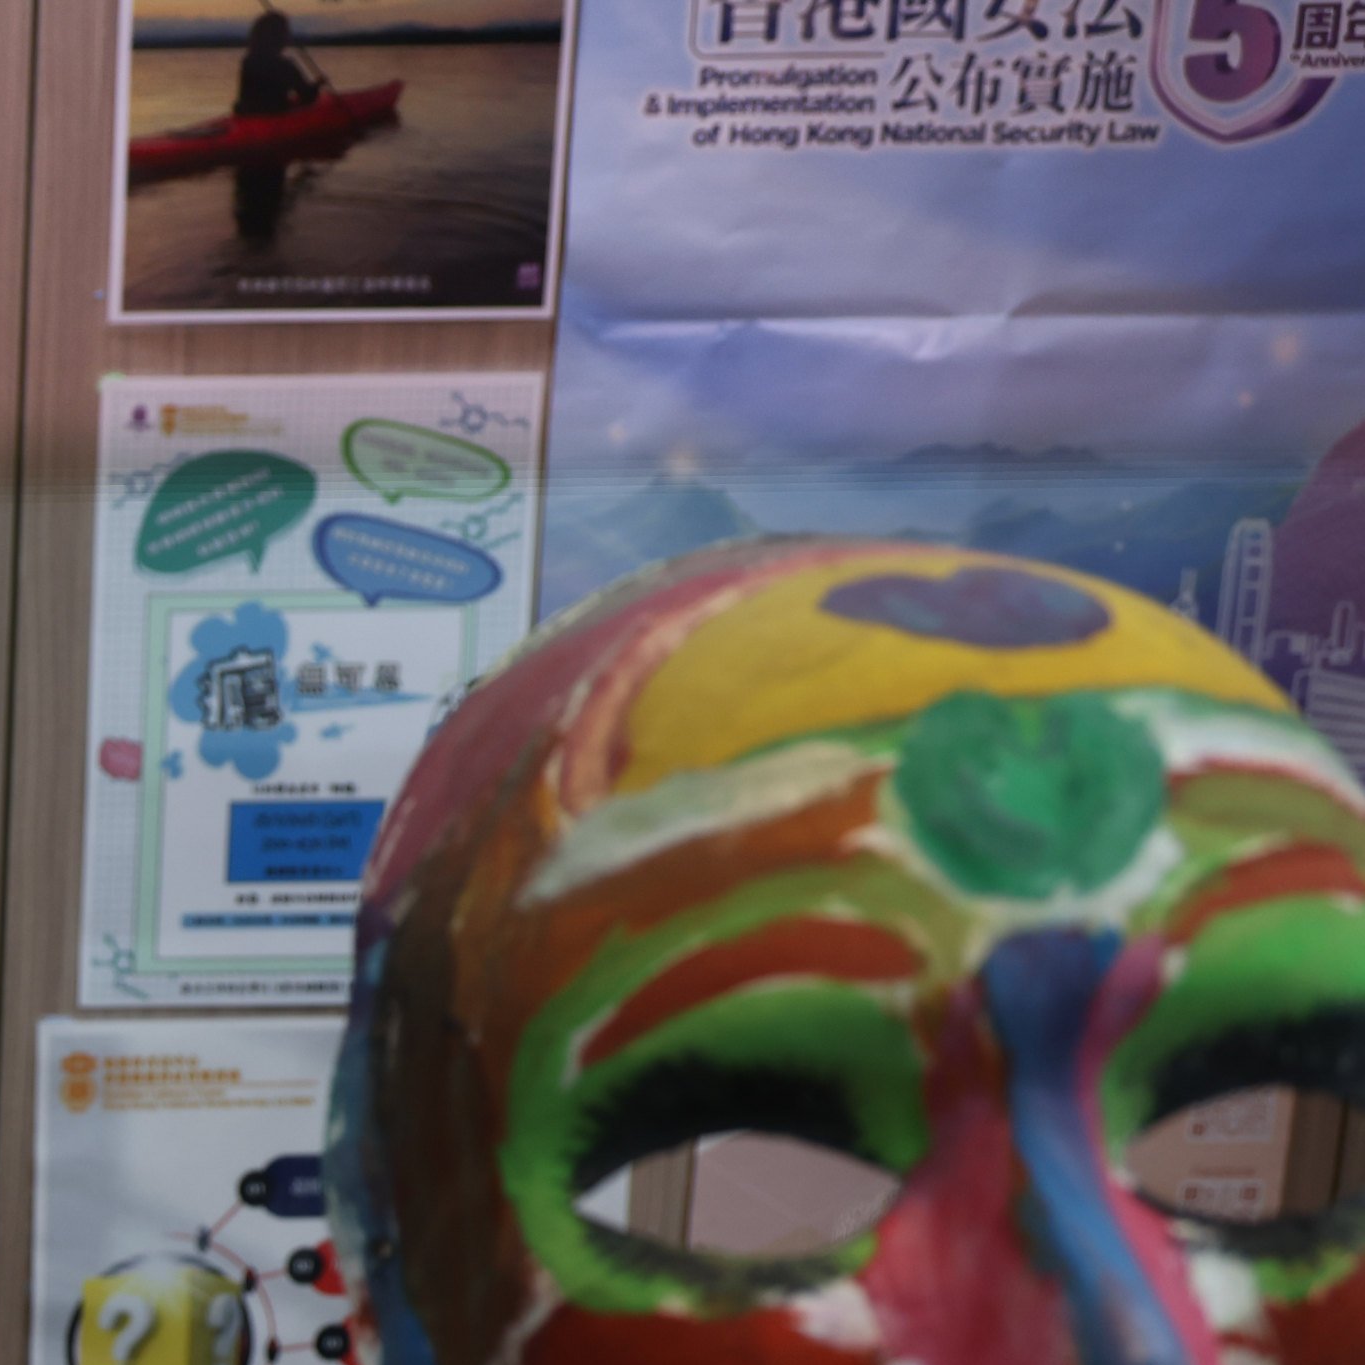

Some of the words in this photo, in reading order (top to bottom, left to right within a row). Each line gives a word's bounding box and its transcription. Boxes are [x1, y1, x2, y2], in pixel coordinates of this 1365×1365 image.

[1184, 0, 1282, 103] 5
[699, 66, 879, 88] Promulgation
[889, 51, 1139, 115] 公布實施
[667, 93, 876, 118] Implementation
[692, 122, 719, 146] of
[729, 123, 800, 147] Hong
[806, 122, 874, 147] Kong
[880, 121, 985, 143] National
[993, 121, 1102, 147] Security
[1108, 121, 1159, 143] Law
